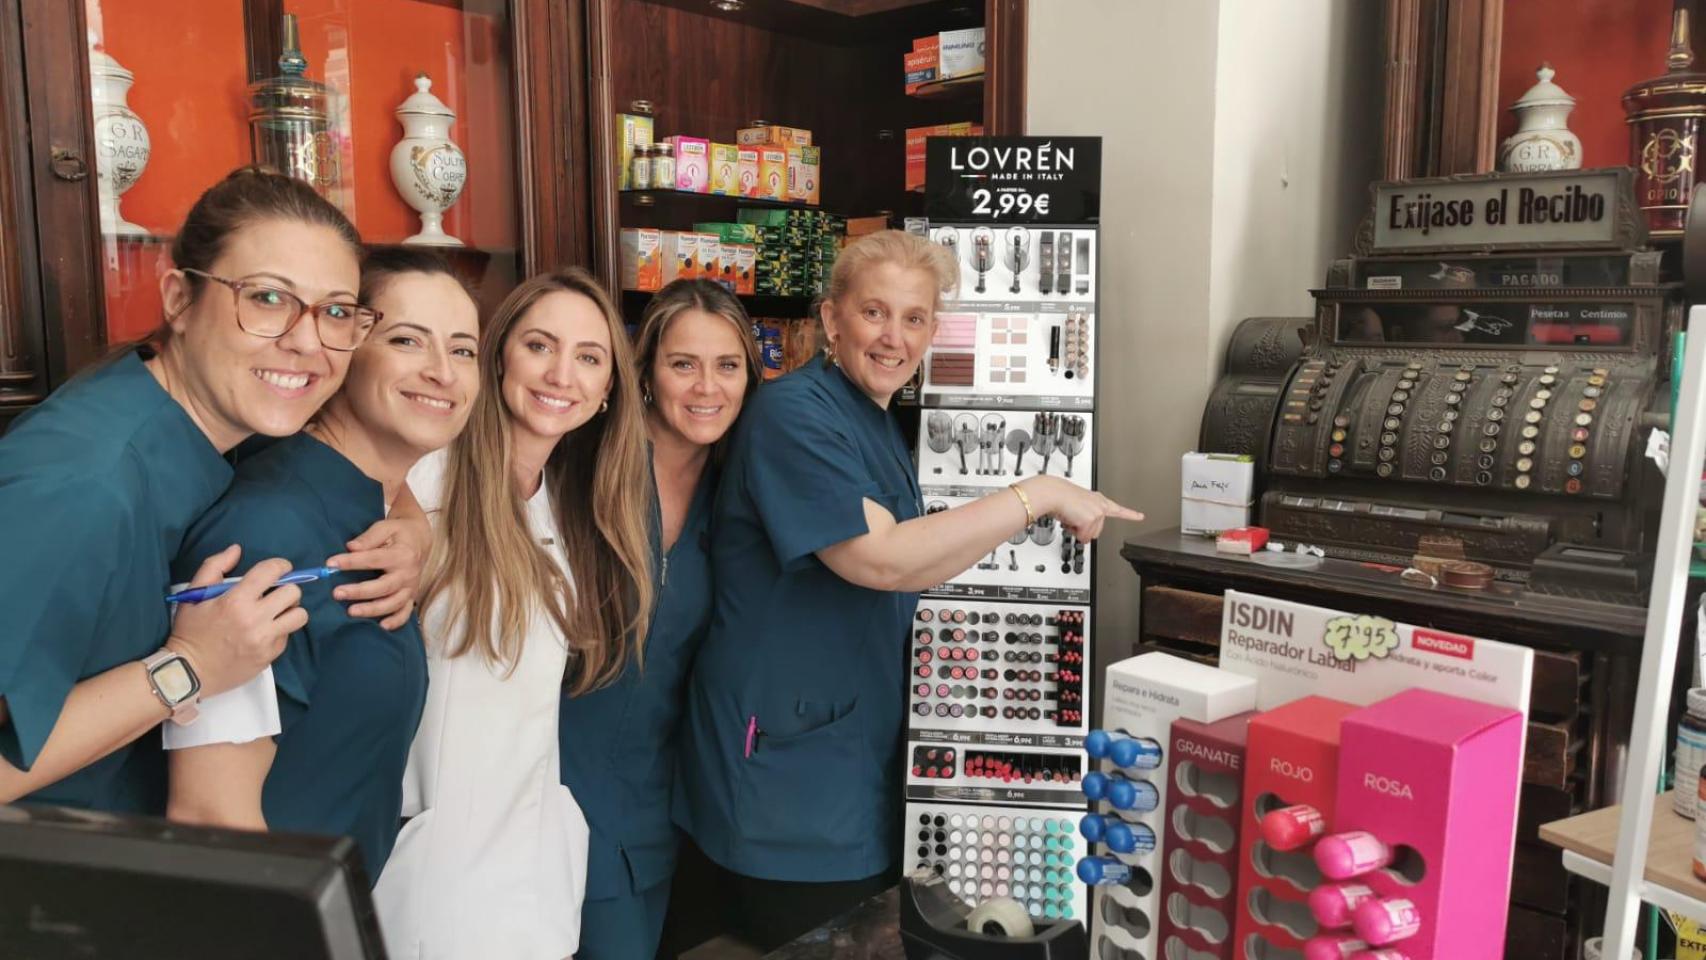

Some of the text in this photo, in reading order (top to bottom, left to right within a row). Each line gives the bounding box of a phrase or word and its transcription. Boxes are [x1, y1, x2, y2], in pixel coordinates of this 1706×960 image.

[951, 141, 1075, 171] LOVRÉN
[992, 173, 1064, 181] MADE IN ITALY
[972, 188, 1049, 218] 2,99€
[1648, 188, 1677, 201] OPIO
[1390, 185, 1604, 235] Exijase el Recibo
[1502, 274, 1560, 286] PAGADO
[1531, 309, 1570, 319] Pesetas
[1229, 600, 1294, 638] ISDIN
[1335, 624, 1387, 649] 7'95
[1416, 636, 1469, 655] NOVEDAD
[1227, 629, 1357, 673] Reparador Labial
[1423, 660, 1431, 670] y
[1432, 663, 1467, 677] aporta
[1468, 668, 1498, 683] Color
[1176, 738, 1241, 769] GRANATE
[1270, 757, 1314, 782] ROJO
[1364, 772, 1414, 800] ROSA
